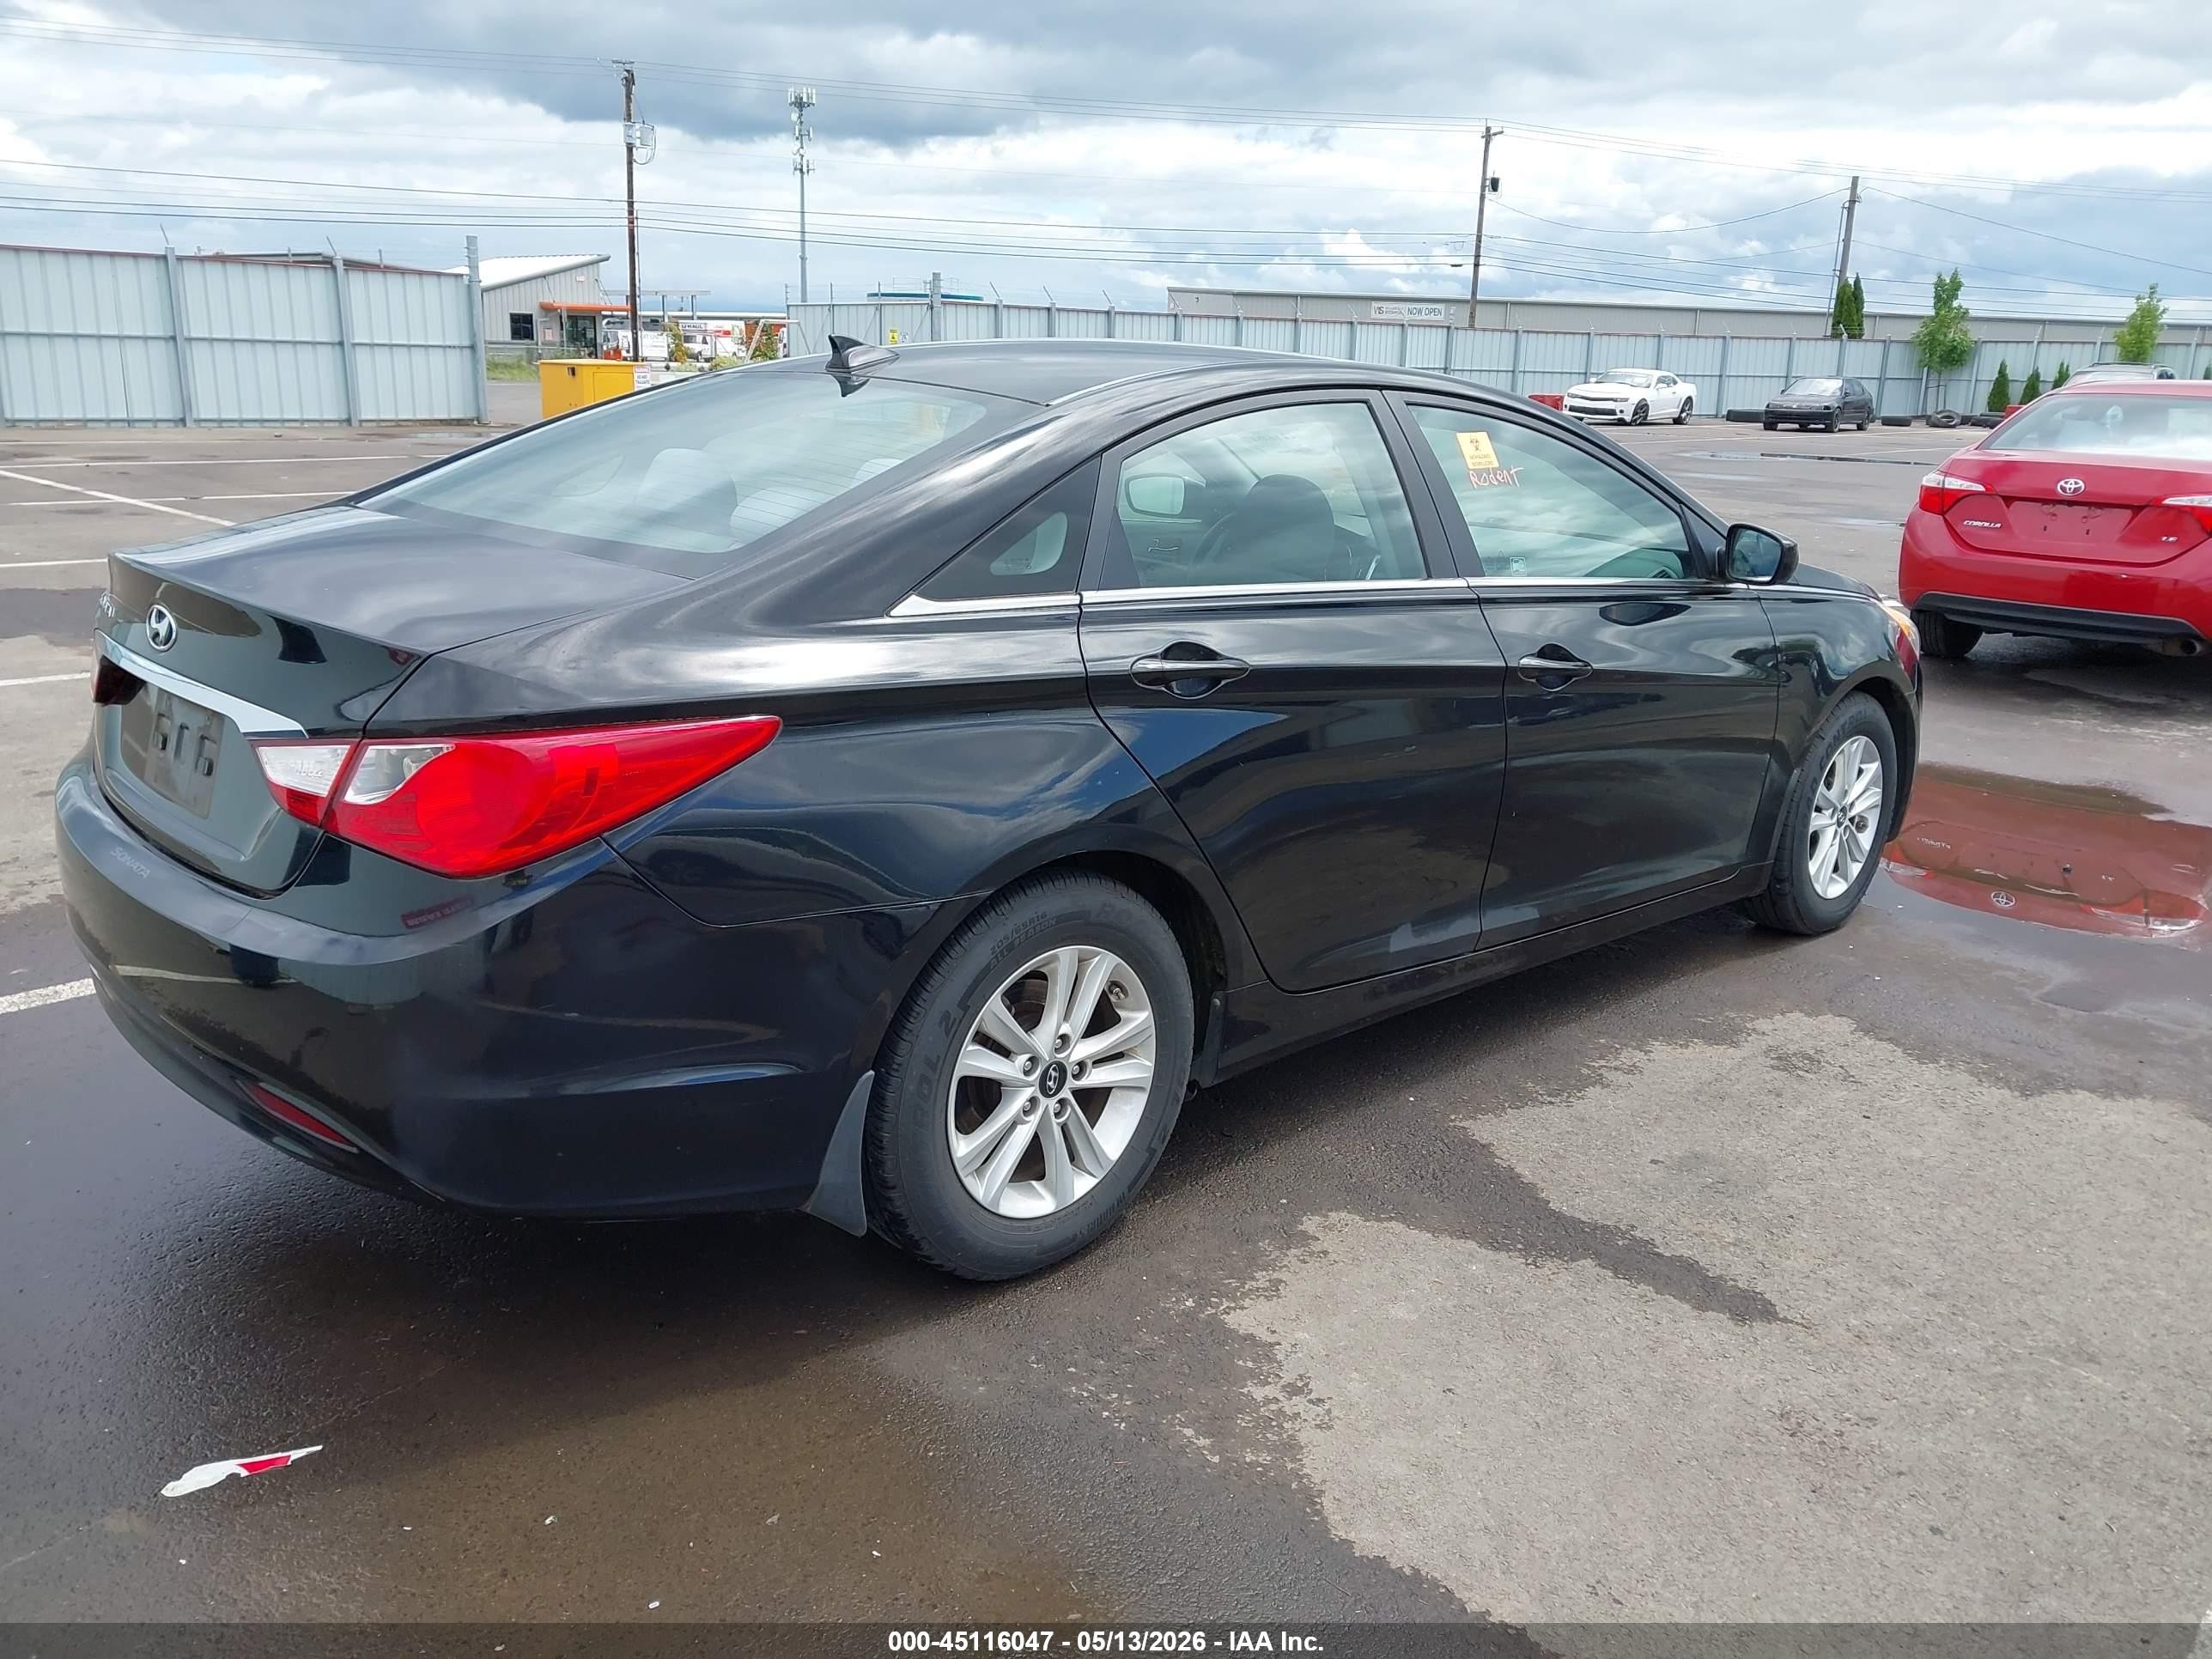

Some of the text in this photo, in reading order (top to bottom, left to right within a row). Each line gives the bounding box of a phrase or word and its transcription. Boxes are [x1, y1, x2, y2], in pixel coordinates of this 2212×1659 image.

[1407, 307, 1424, 316] NOW
[1425, 307, 1443, 317] OPEN
[110, 847, 151, 878] SONATA
